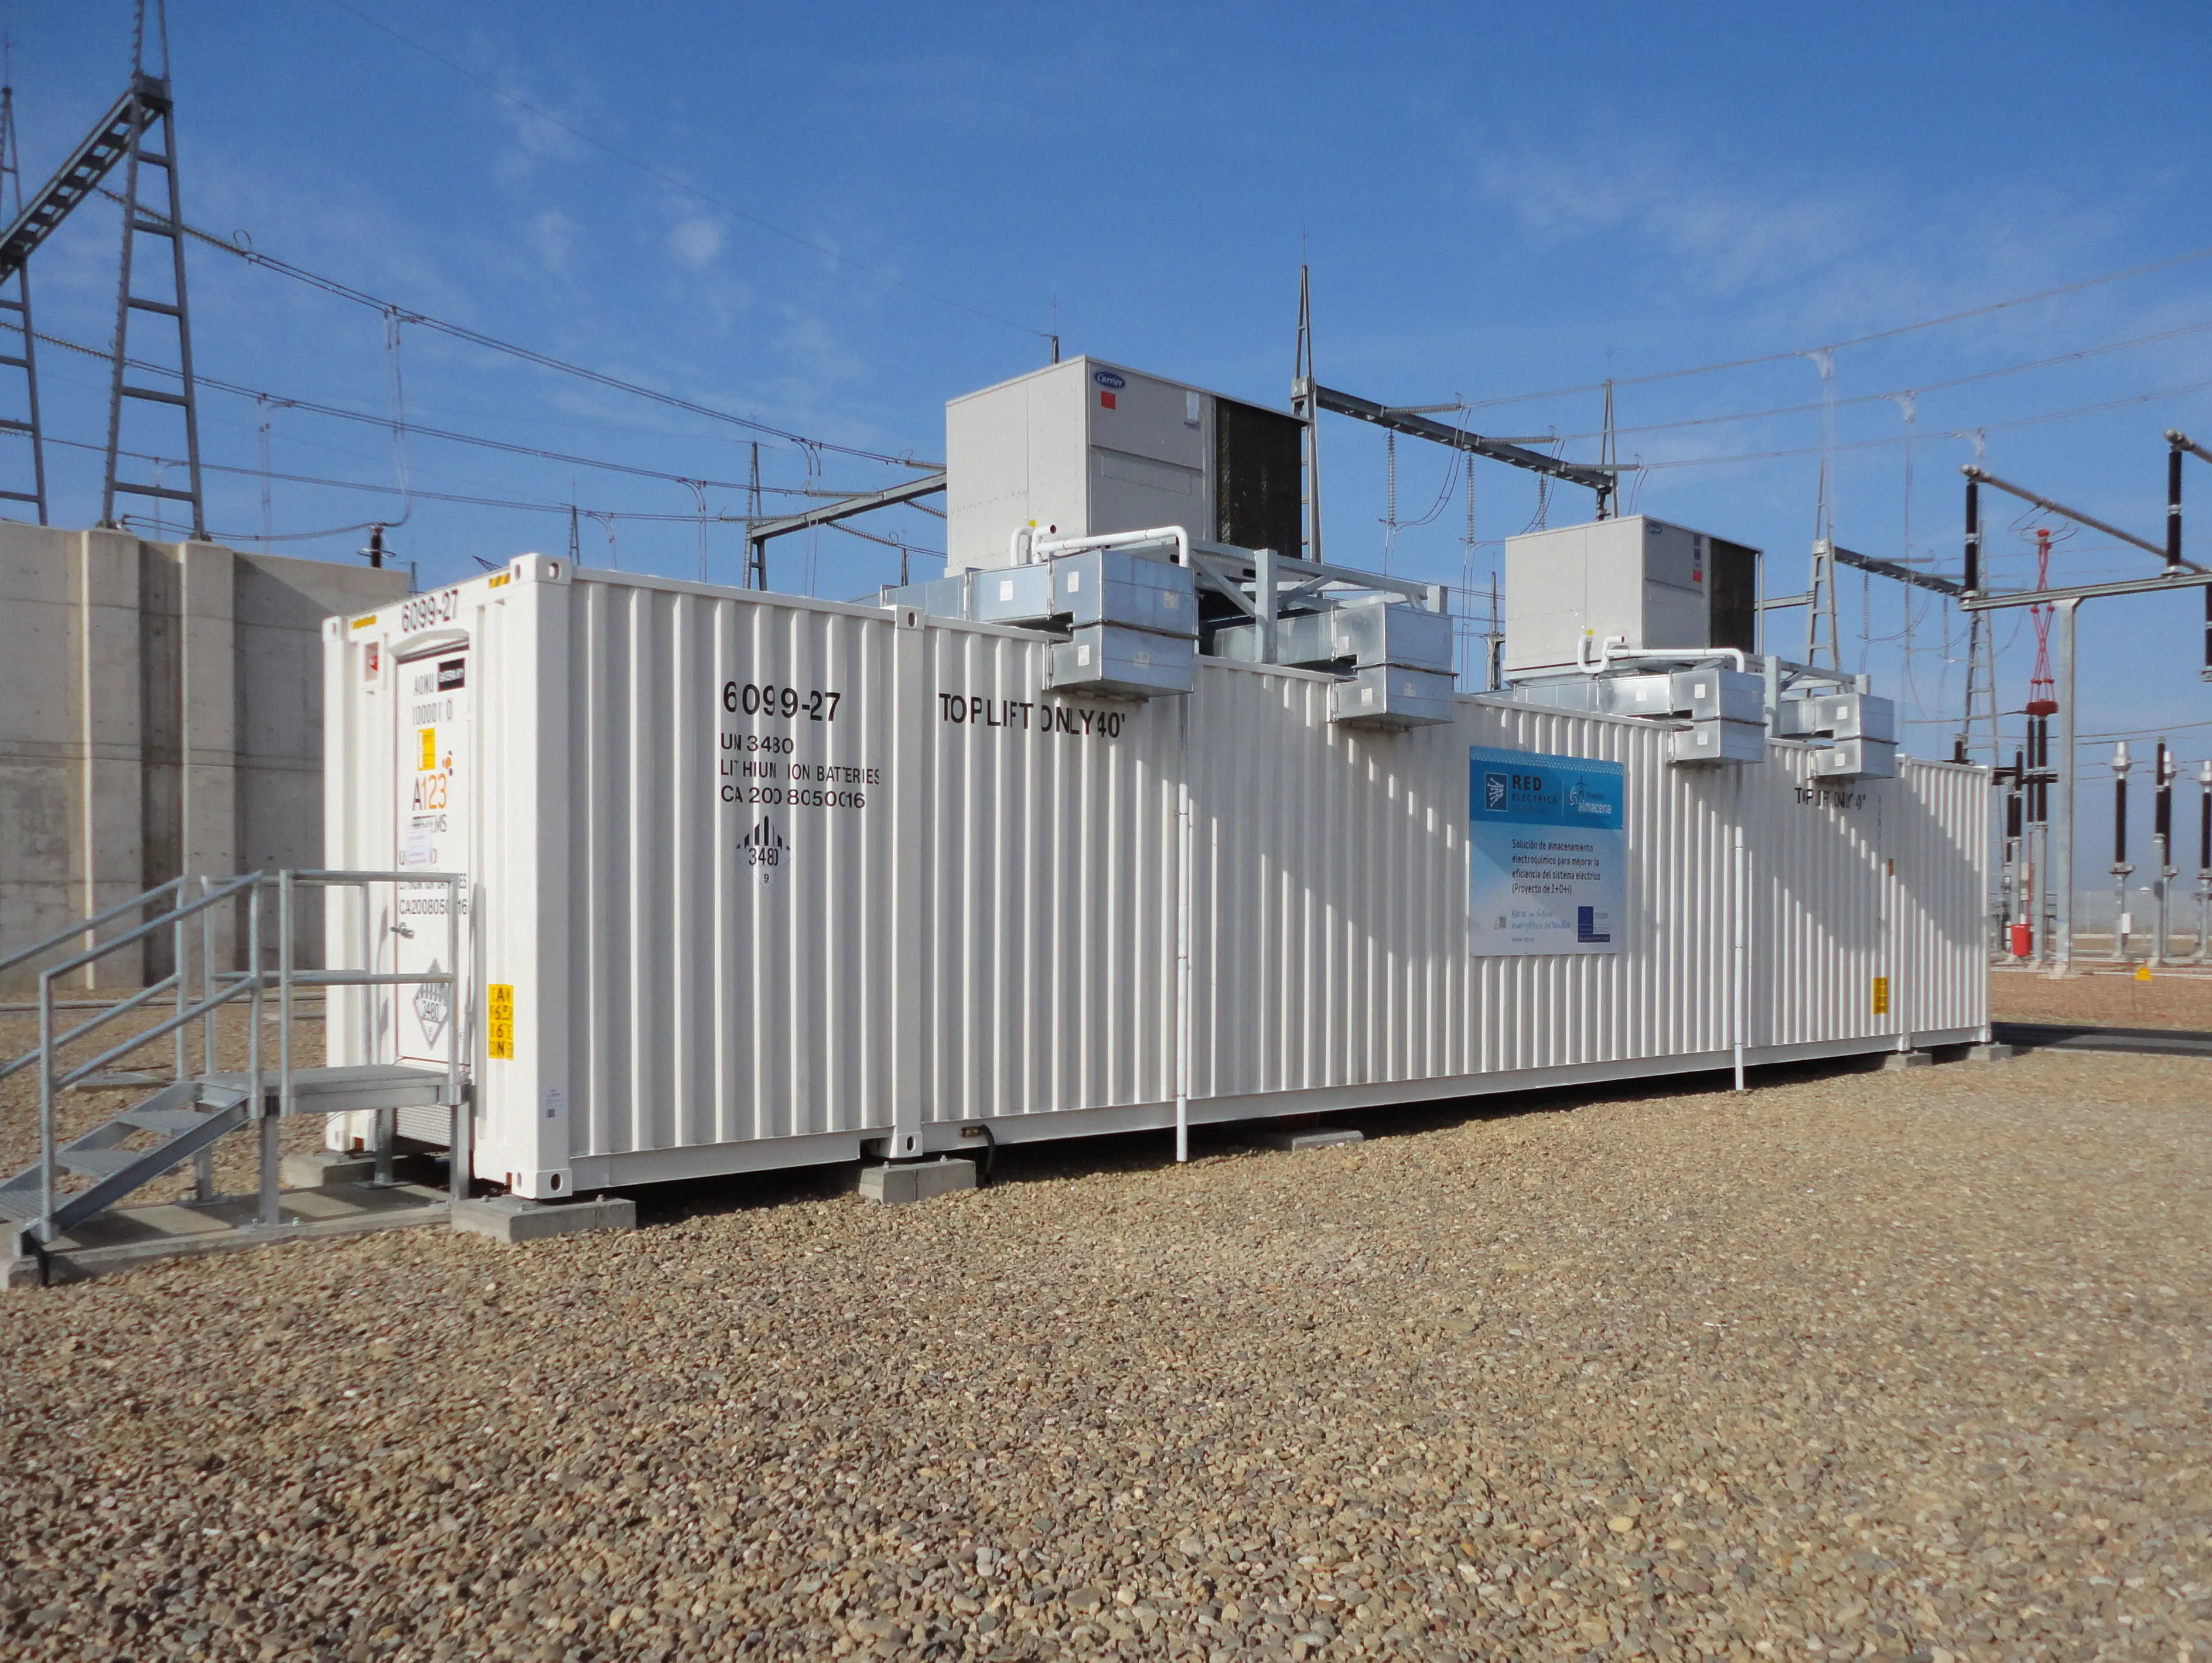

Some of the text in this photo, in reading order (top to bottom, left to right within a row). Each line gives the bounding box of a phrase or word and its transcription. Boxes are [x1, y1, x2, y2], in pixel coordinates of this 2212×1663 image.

[402, 588, 458, 633] 6099-27
[723, 681, 841, 722] 6099-27
[939, 694, 982, 724] TOP
[987, 699, 1033, 730] LIFT
[1042, 705, 1095, 736] ONLY
[721, 733, 794, 754] UN 3480
[787, 764, 810, 780] ION
[817, 766, 879, 785] BATTERIES
[1513, 774, 1542, 791] RED
[412, 774, 447, 811] A123
[1578, 800, 1612, 814] almacena
[1512, 839, 1593, 852] Solución de almacenamiento
[1558, 858, 1571, 866] para
[1572, 858, 1593, 868] mejorar
[1595, 858, 1599, 866] la
[1512, 869, 1541, 878] eficiencia
[1542, 870, 1551, 879] del
[1552, 870, 1575, 880] sistema
[1512, 883, 1542, 895] (Proyecto
[1542, 885, 1550, 893] de
[400, 899, 467, 915] CA200805016
